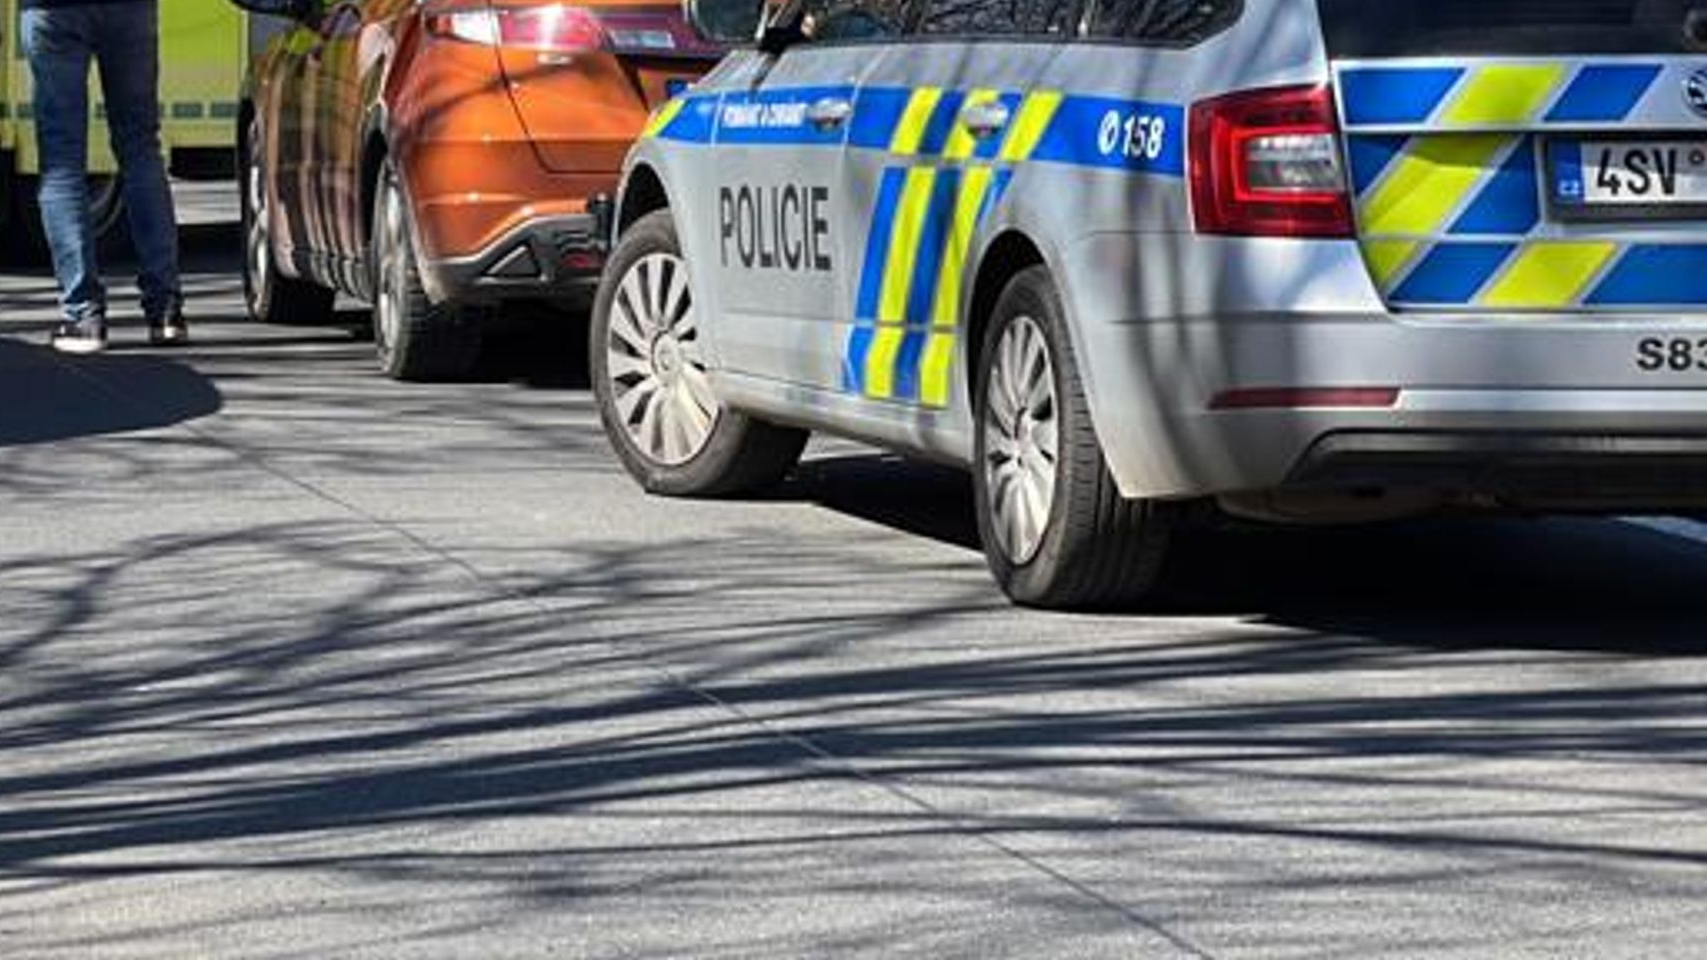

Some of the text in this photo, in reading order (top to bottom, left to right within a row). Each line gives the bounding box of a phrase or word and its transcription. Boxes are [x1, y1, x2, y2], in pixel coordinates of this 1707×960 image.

[1122, 114, 1166, 159] 158
[1597, 147, 1677, 196] 4SV
[719, 183, 833, 272] POLICIE
